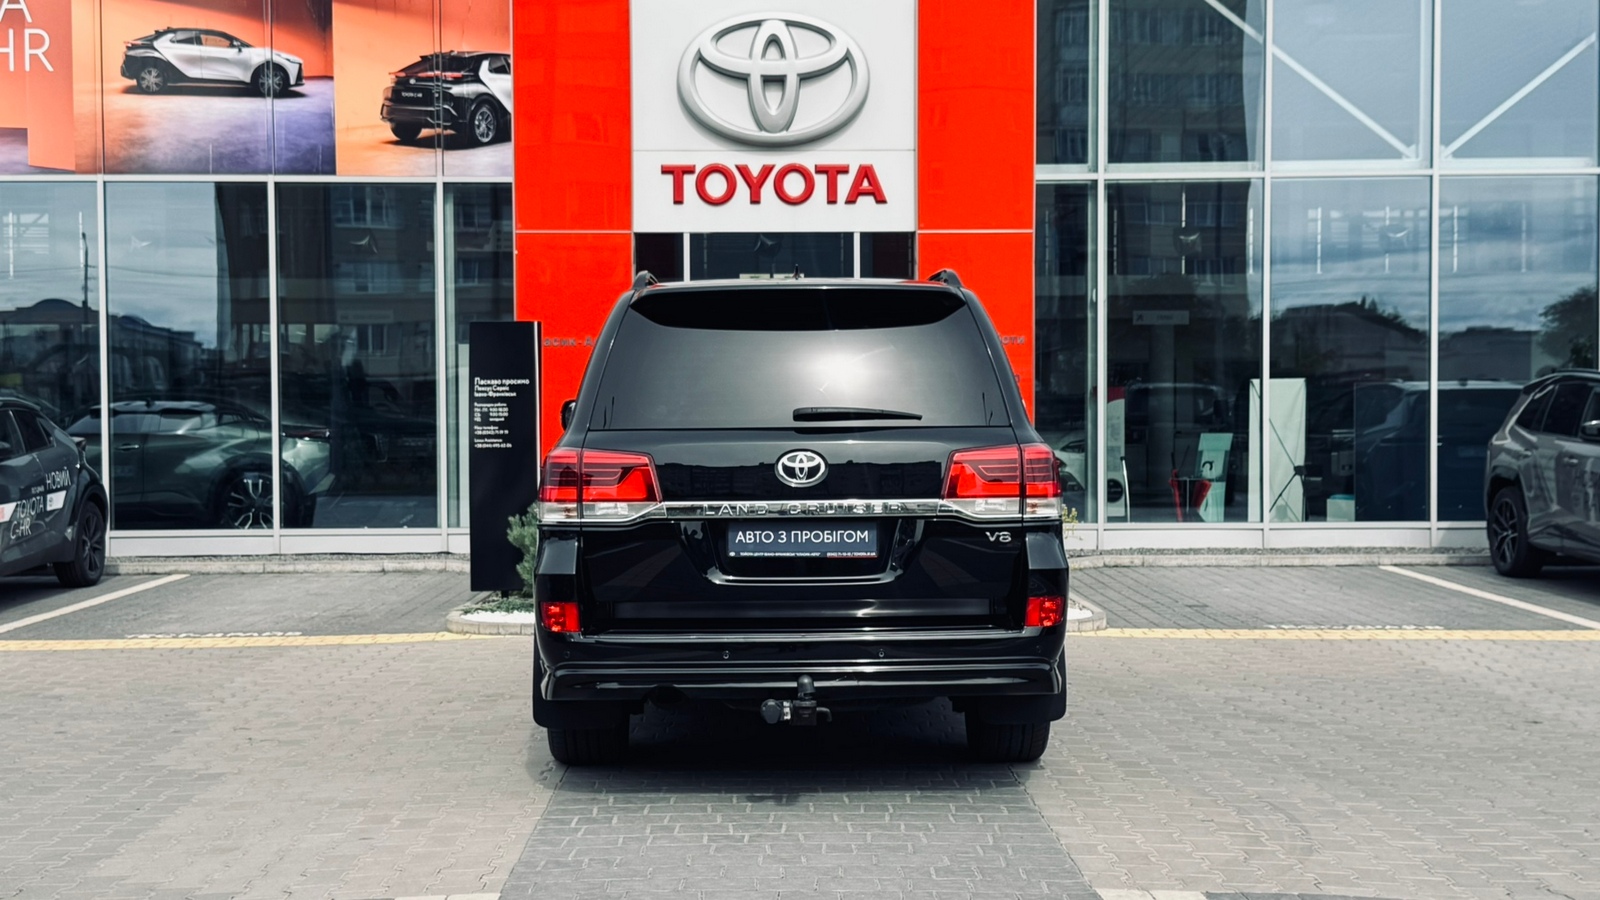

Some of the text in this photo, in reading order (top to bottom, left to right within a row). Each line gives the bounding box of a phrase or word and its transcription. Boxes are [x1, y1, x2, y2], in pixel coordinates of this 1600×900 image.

[661, 163, 888, 206] TOYOTA
[46, 466, 71, 490] НОВИЙ
[16, 495, 45, 519] TOYOTA
[703, 502, 902, 515] LAND CRUISER
[10, 518, 32, 539] C-HR
[735, 530, 775, 544] АВТО
[791, 530, 869, 543] ПРОБІГОМ
[985, 531, 1012, 542] V8
